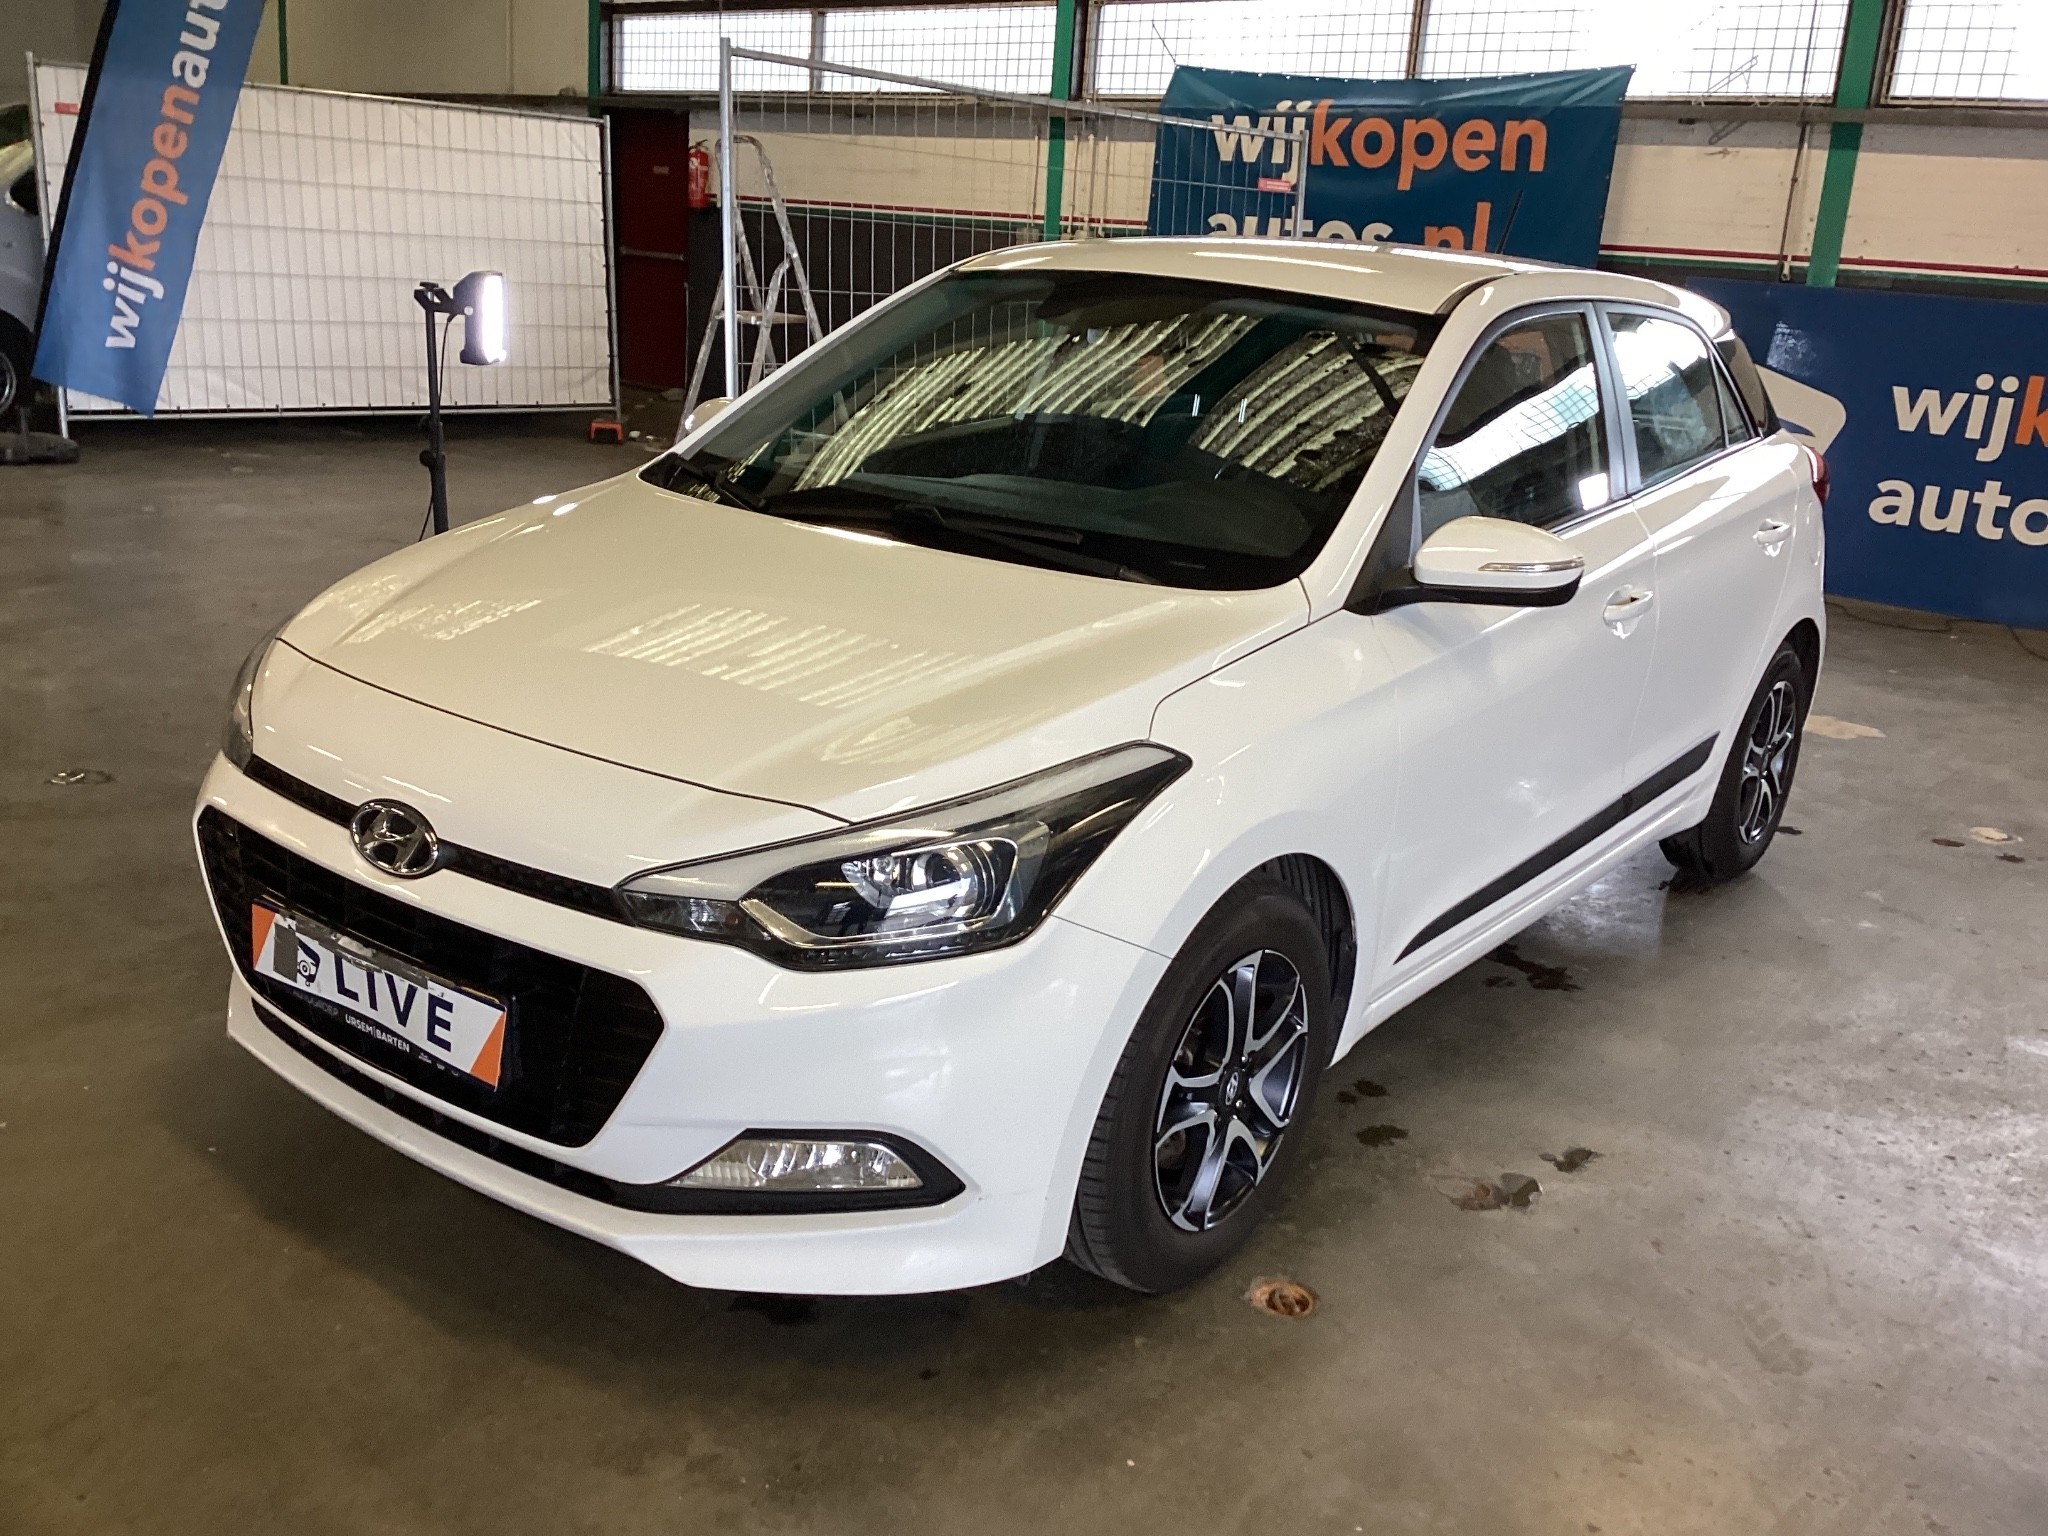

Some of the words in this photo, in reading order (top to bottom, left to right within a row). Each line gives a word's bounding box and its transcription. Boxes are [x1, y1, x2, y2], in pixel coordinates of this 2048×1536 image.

[1211, 98, 1547, 191] wijkopen
[1892, 373, 2048, 462] wijk
[1868, 479, 2048, 546] auto
[334, 953, 453, 1053] LIVE
